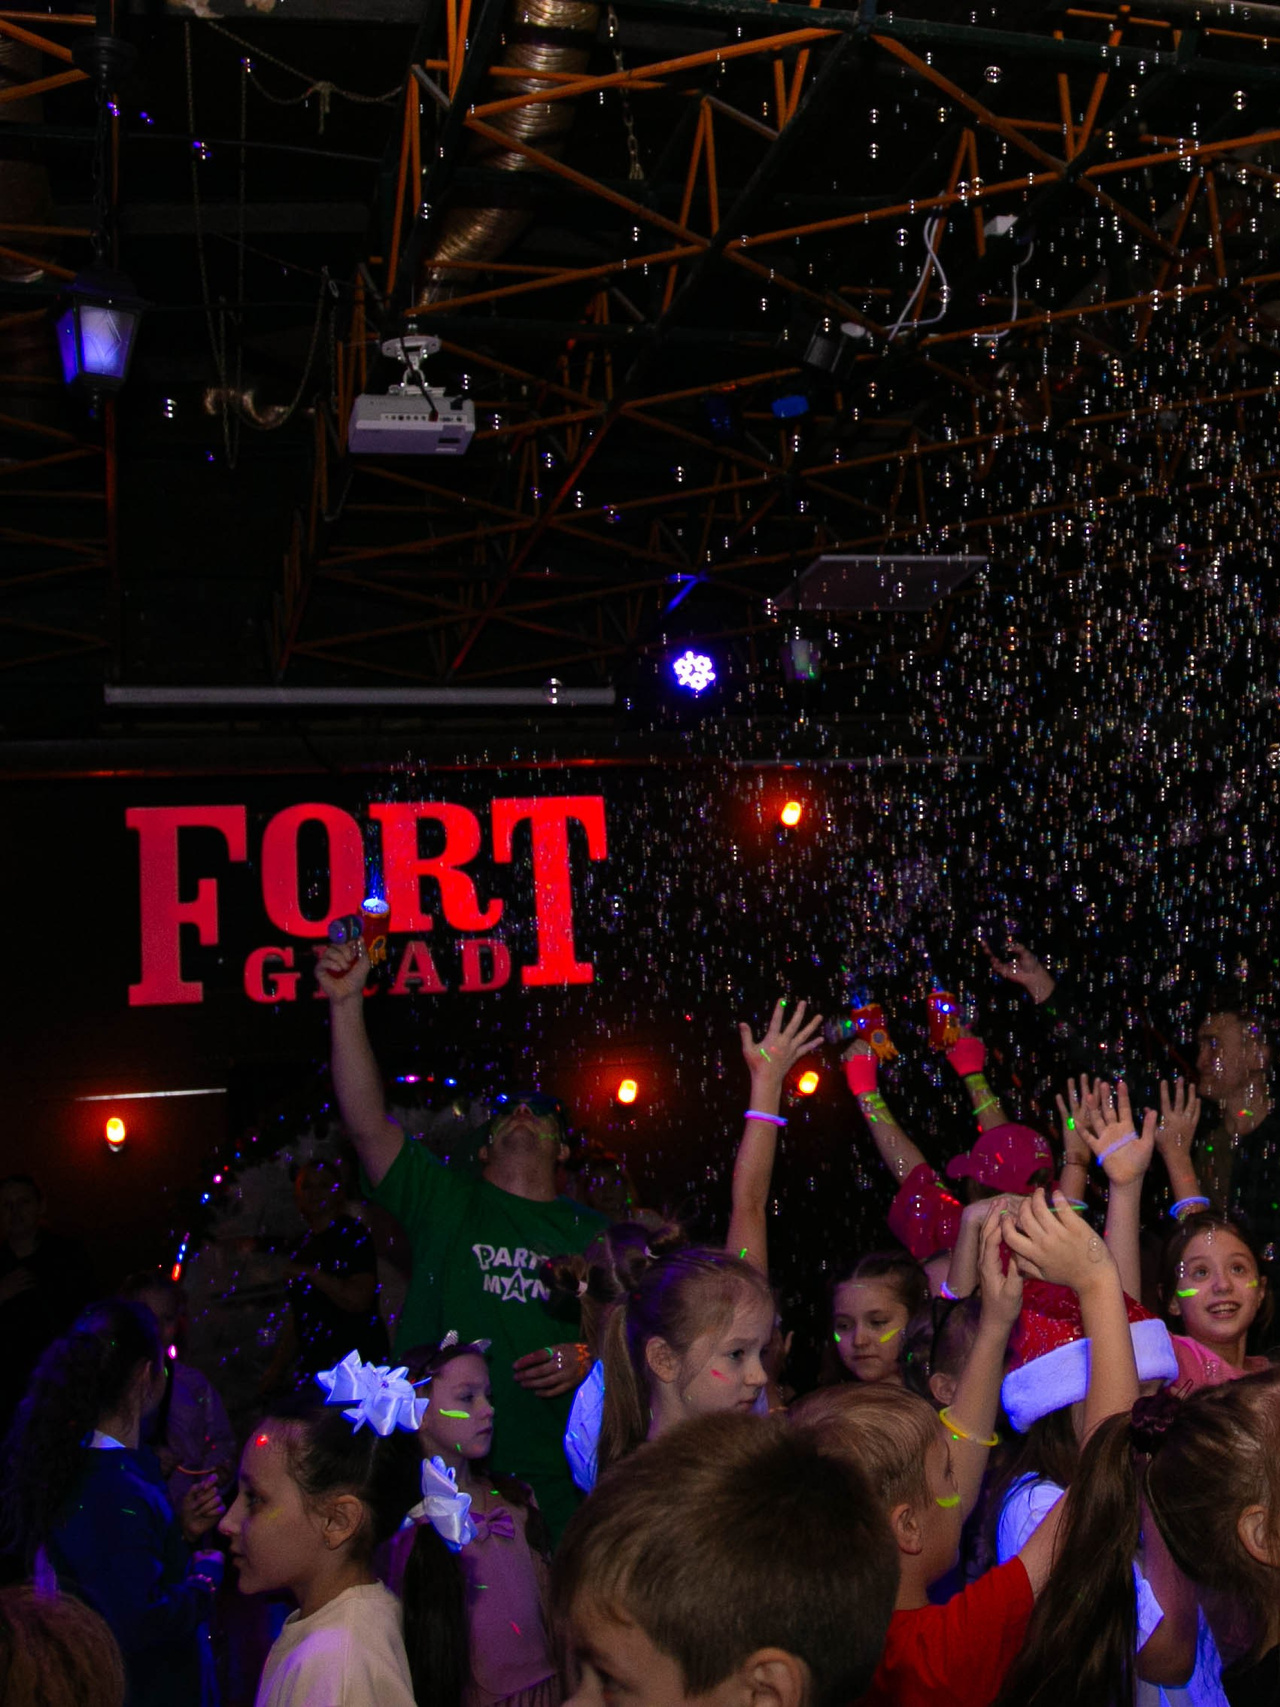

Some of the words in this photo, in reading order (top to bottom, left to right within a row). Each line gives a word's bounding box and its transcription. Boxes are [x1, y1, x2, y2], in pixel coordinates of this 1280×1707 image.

[125, 795, 608, 1006] FORT
[243, 938, 512, 1004] GAD
[483, 1268, 551, 1303] MAN
